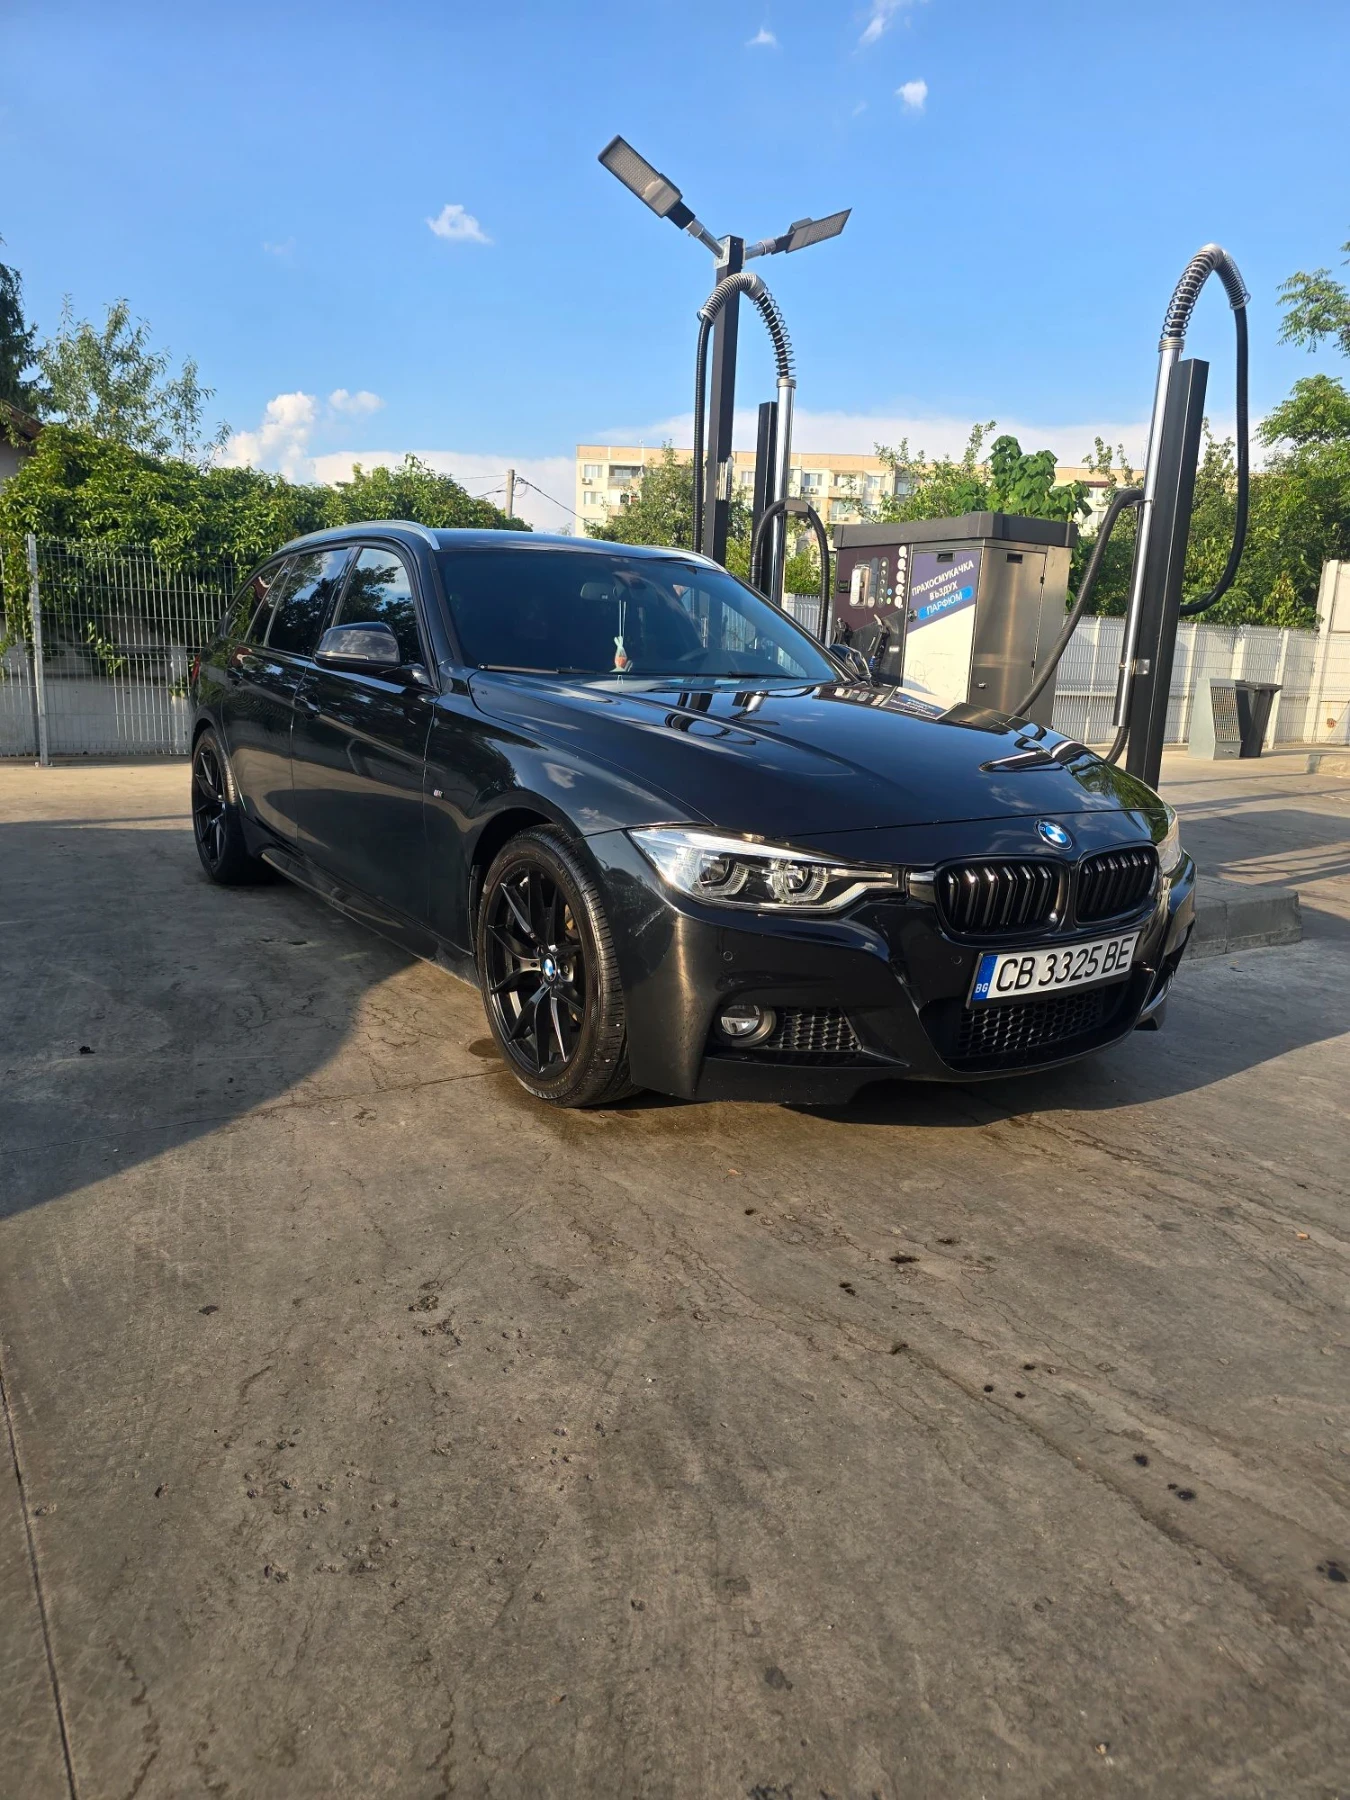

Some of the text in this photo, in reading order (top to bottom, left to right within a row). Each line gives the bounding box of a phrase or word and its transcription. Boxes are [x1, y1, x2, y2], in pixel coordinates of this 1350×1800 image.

[911, 560, 974, 596] ПРАХОСМУКАЧКА
[929, 580, 958, 601] ВЪЗДУХ
[926, 591, 963, 615] ПАРФЮМ
[996, 936, 1134, 992] CB 3325 BE
[975, 982, 989, 994] BG
